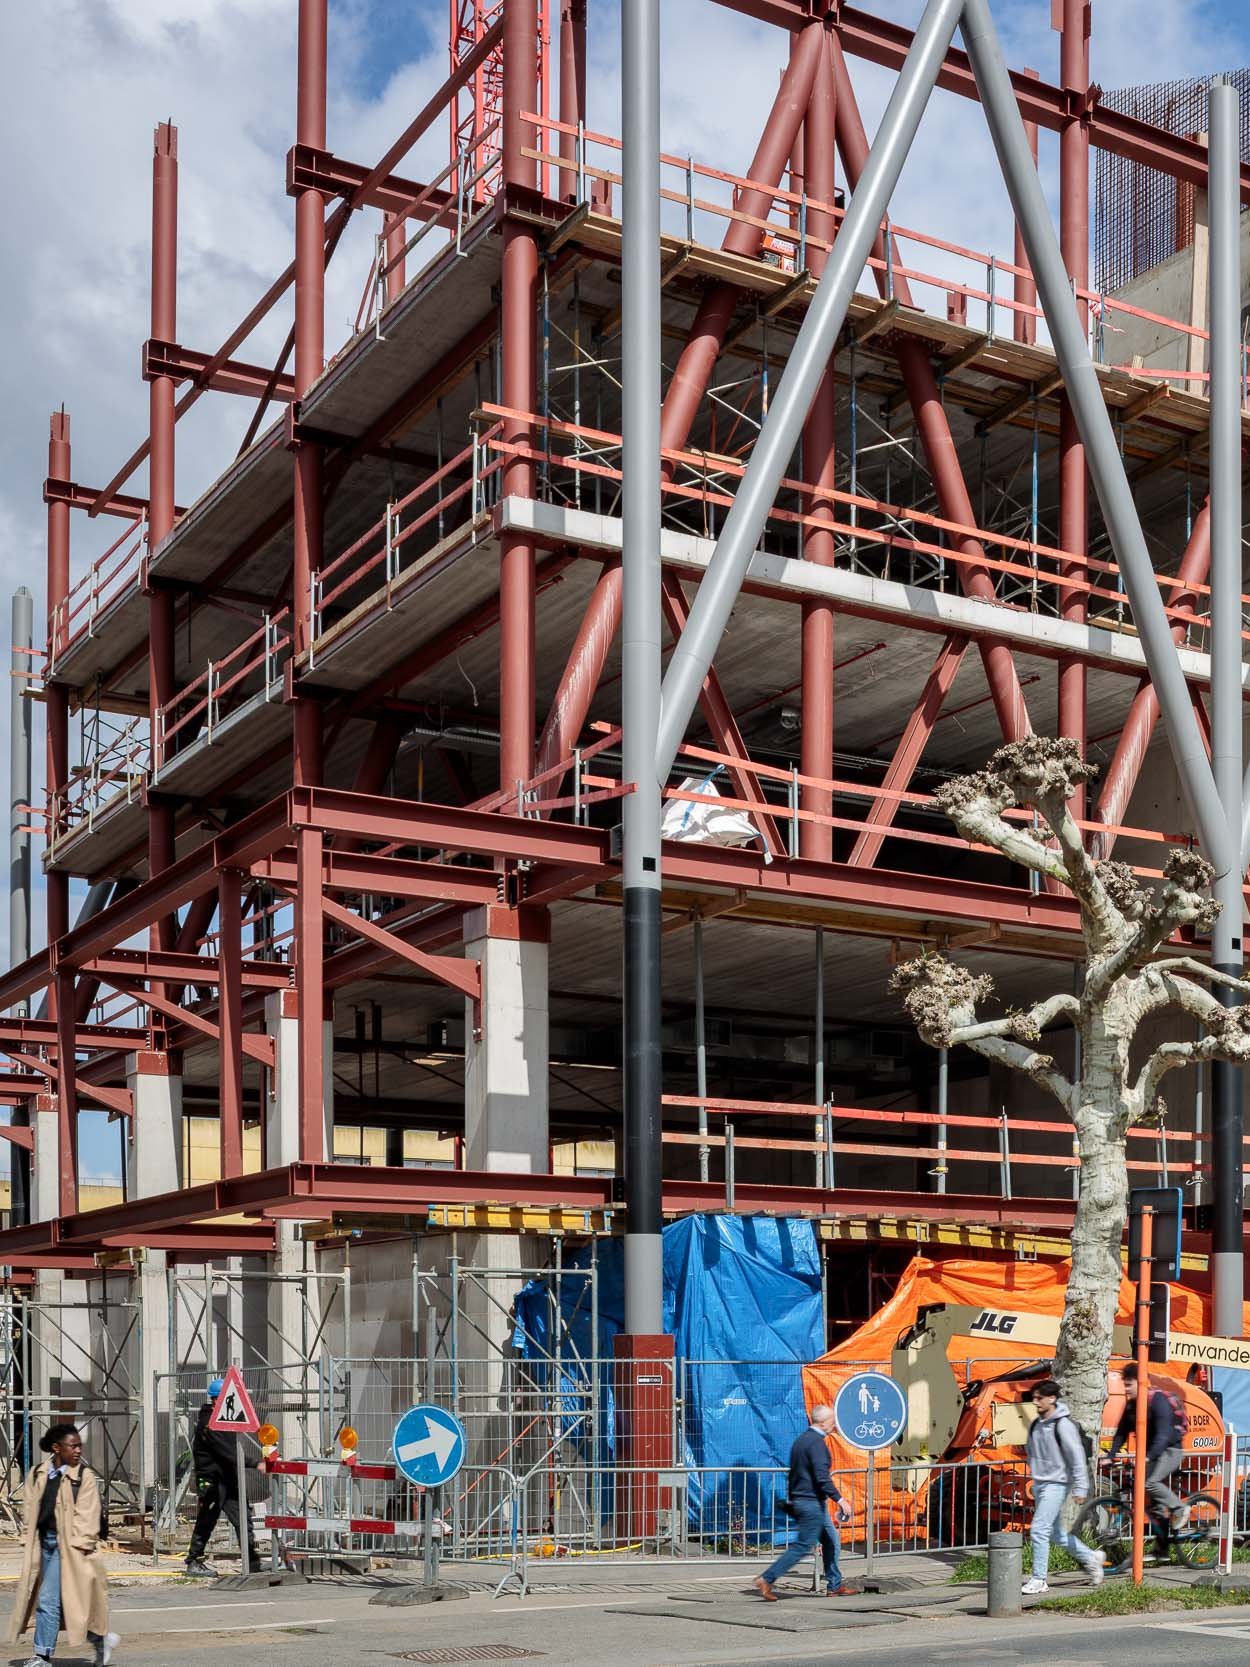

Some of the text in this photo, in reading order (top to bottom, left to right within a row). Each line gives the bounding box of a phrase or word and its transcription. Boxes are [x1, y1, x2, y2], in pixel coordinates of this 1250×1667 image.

[970, 1312, 1018, 1334] JLG
[1193, 1415, 1210, 1426] BOER
[1193, 1436, 1218, 1448] 600AJ
